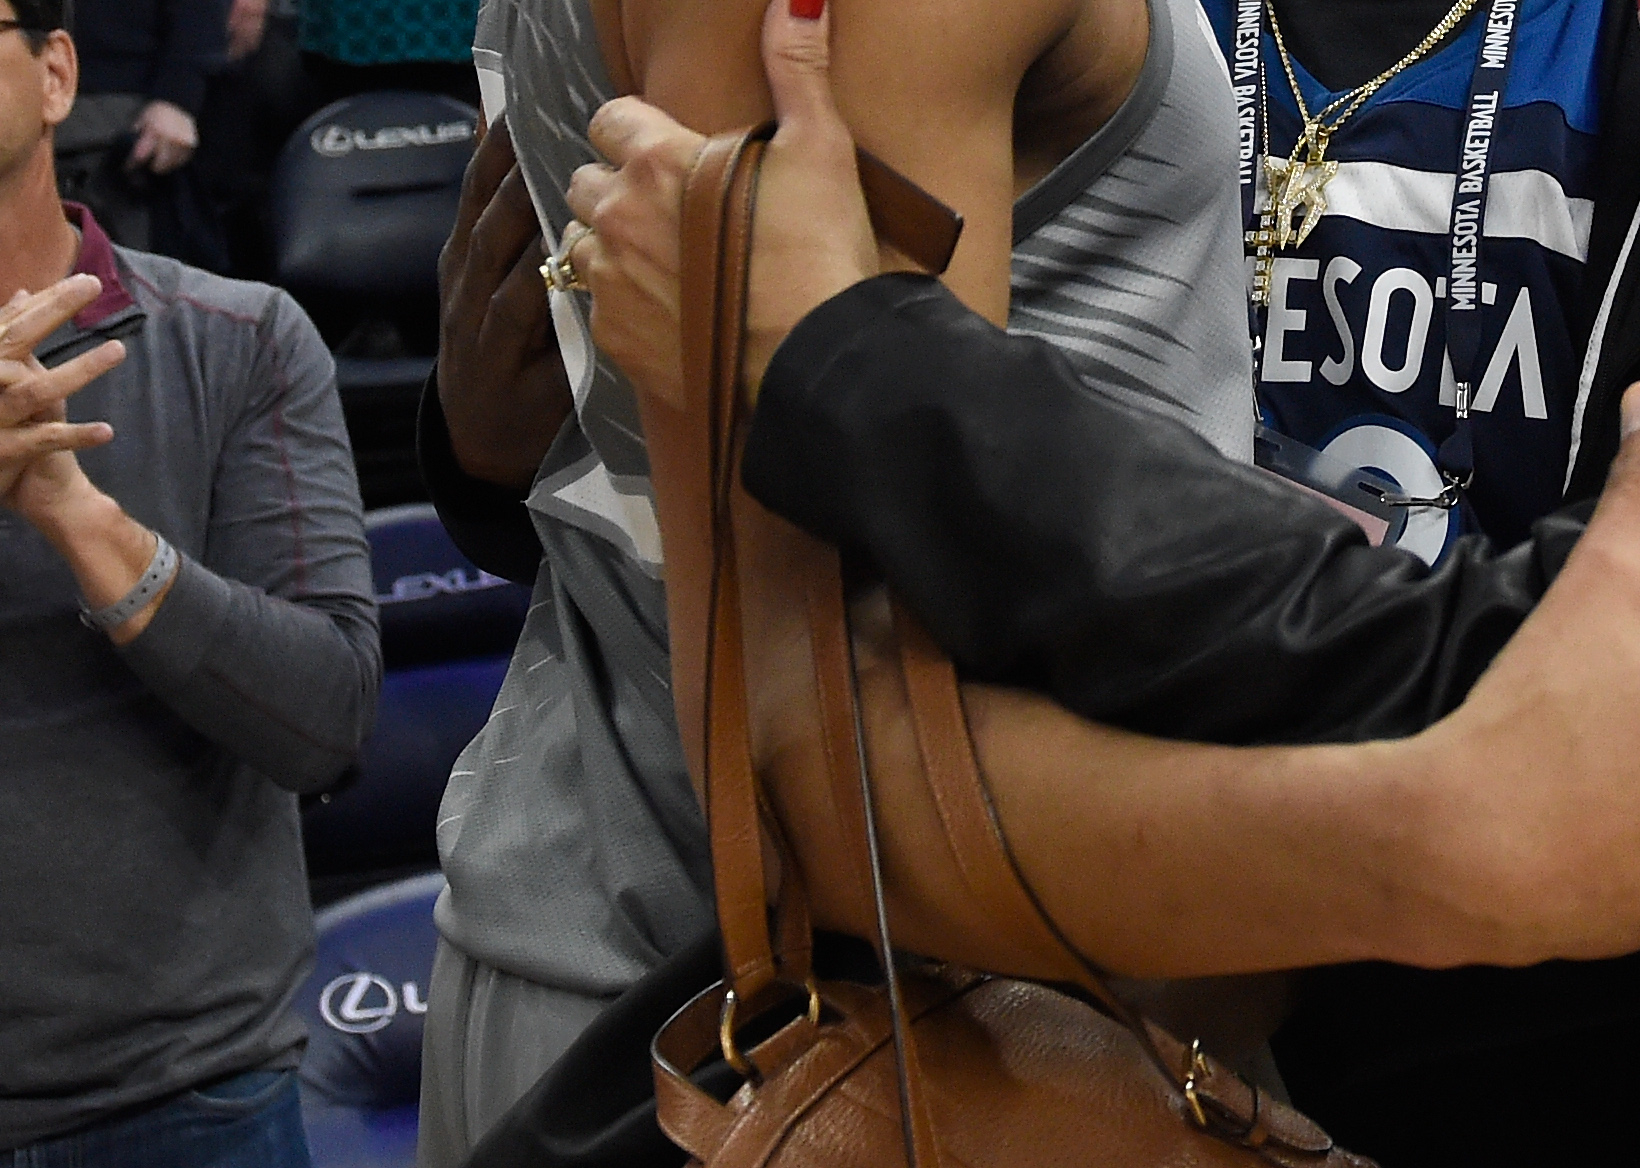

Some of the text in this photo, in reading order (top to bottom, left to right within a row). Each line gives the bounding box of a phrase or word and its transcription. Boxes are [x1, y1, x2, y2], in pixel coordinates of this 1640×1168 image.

[353, 120, 473, 151] LEXUS
[1451, 89, 1499, 311] MINNESOTA BASKETBALL
[372, 567, 512, 605] EXU
